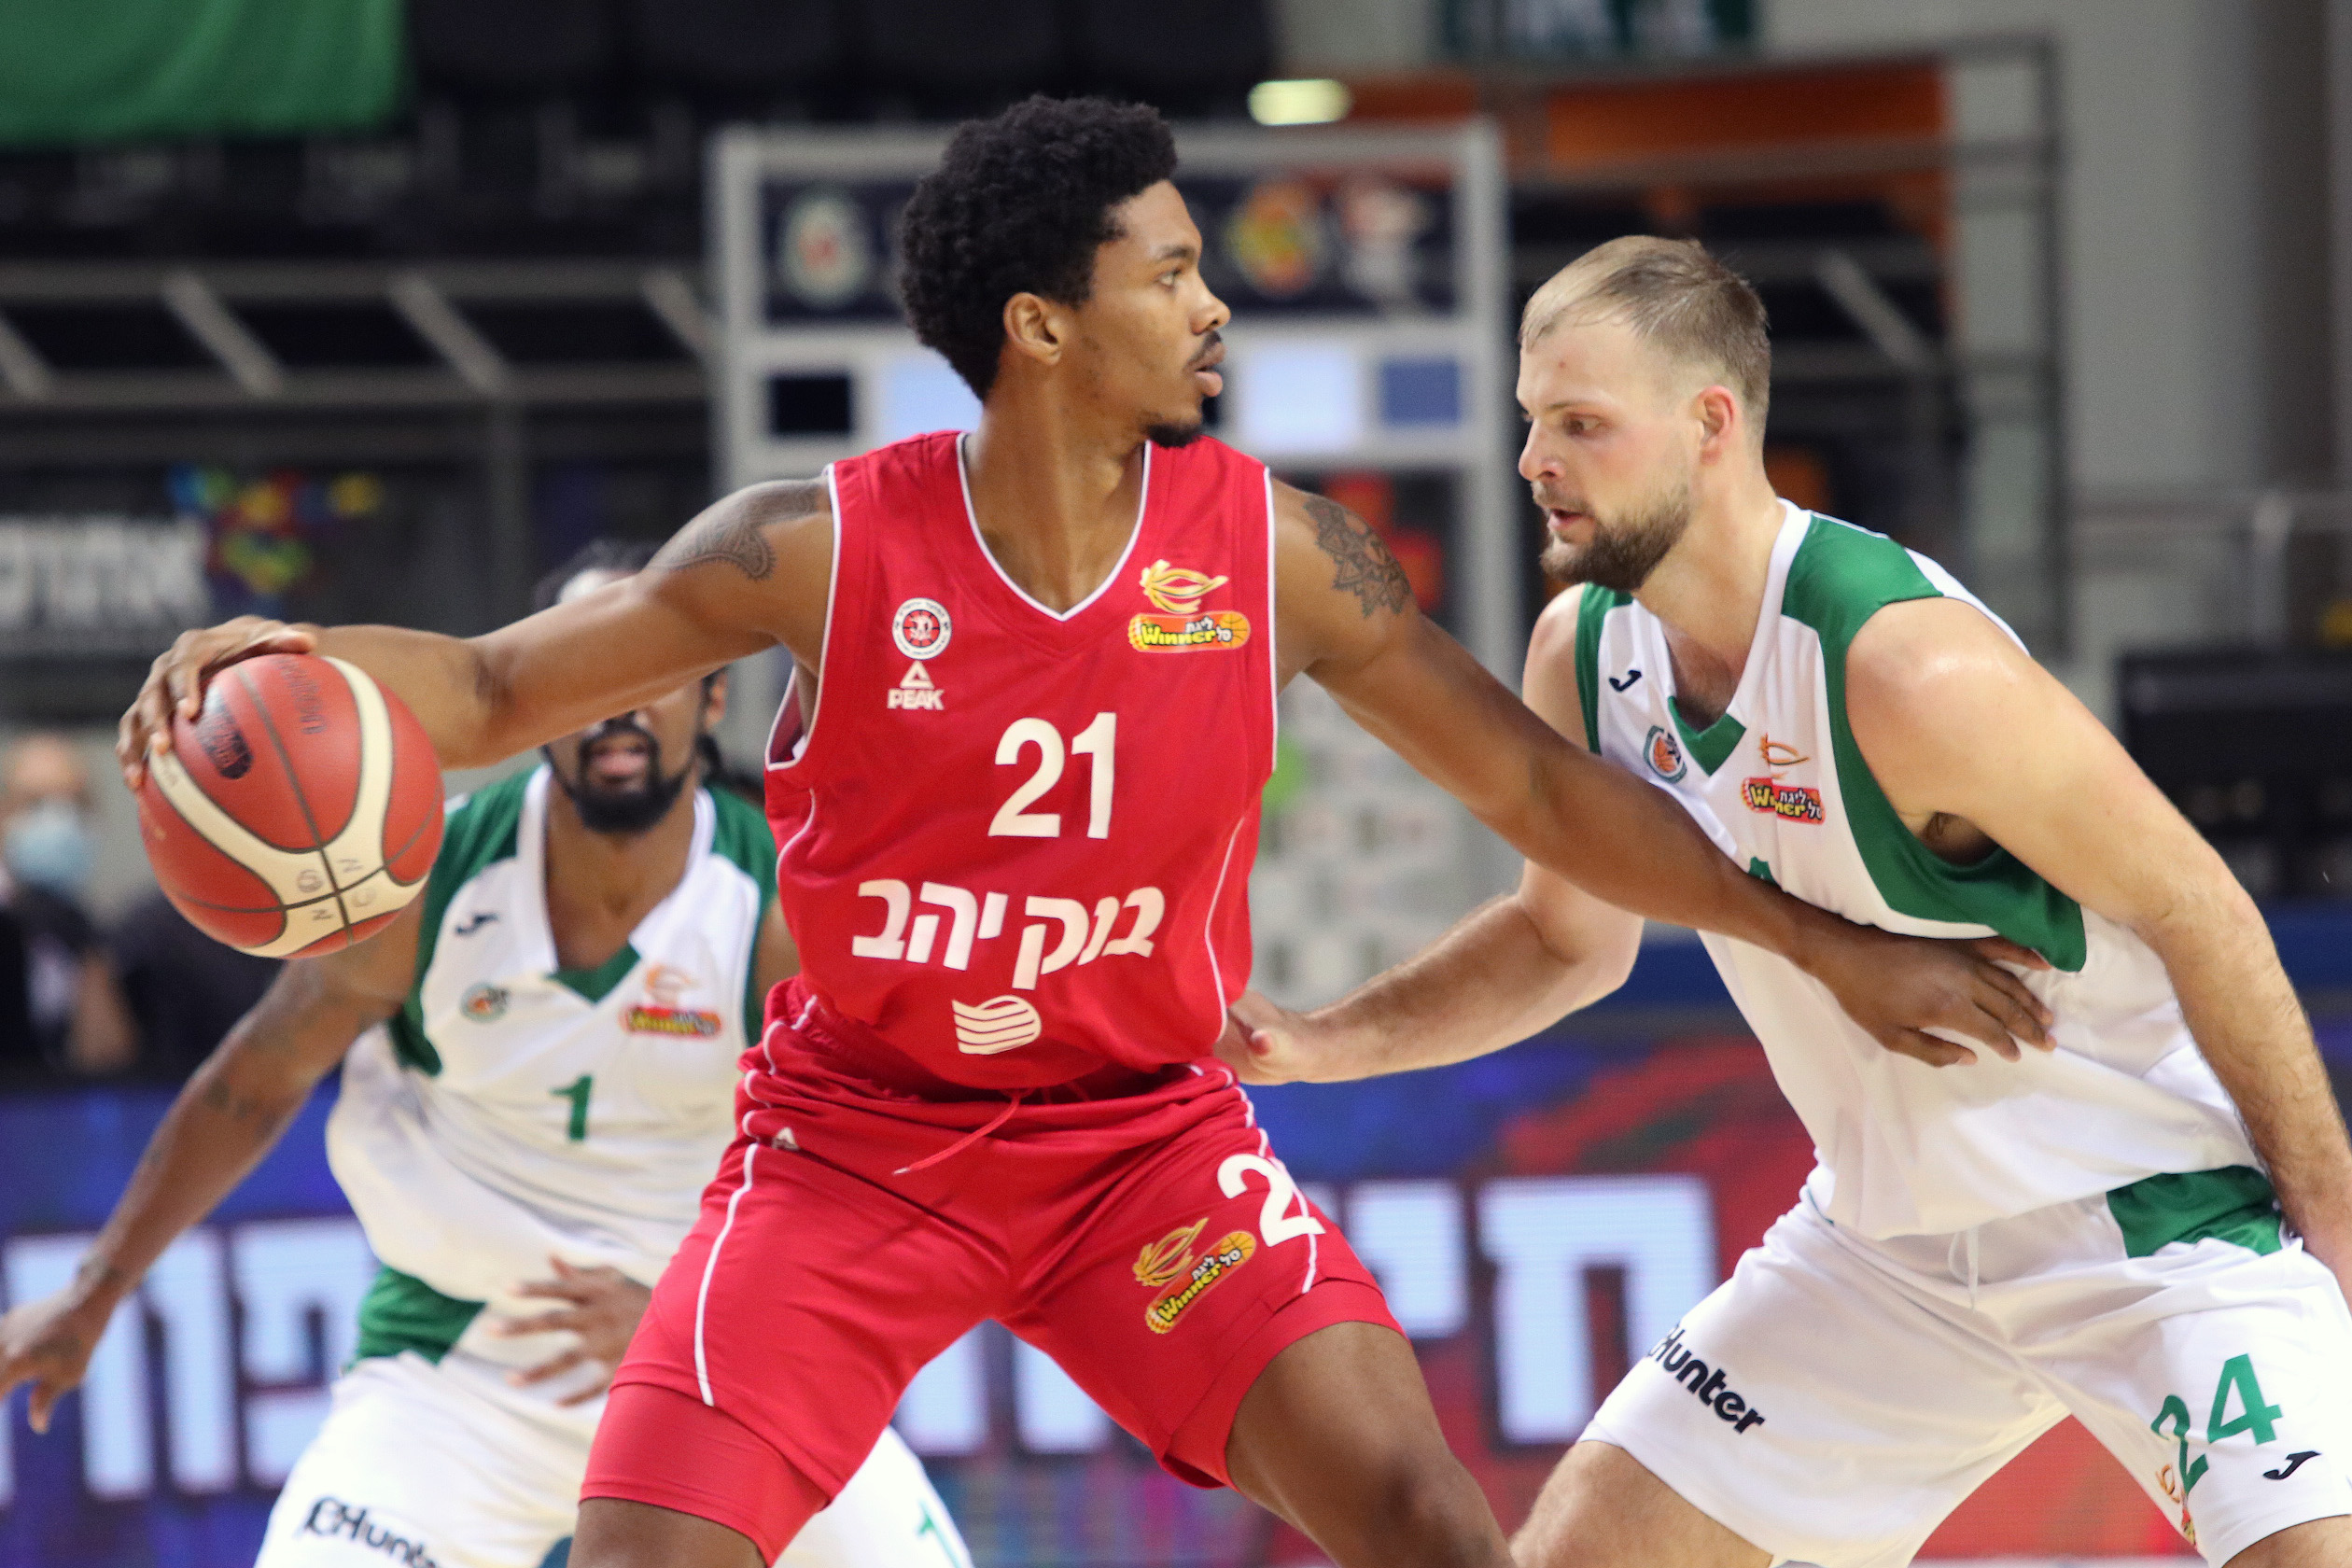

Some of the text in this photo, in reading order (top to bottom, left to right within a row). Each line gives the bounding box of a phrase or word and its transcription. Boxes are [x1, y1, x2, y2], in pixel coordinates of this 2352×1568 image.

[1141, 623, 1217, 645] Winner
[887, 688, 945, 710] PEAK
[987, 711, 1117, 840] 21
[852, 878, 1165, 990] בנק יהב
[549, 1073, 594, 1141] 1
[1217, 1154, 1325, 1247] 2
[1156, 1262, 1223, 1322] Winner
[2150, 1353, 2284, 1496] 24
